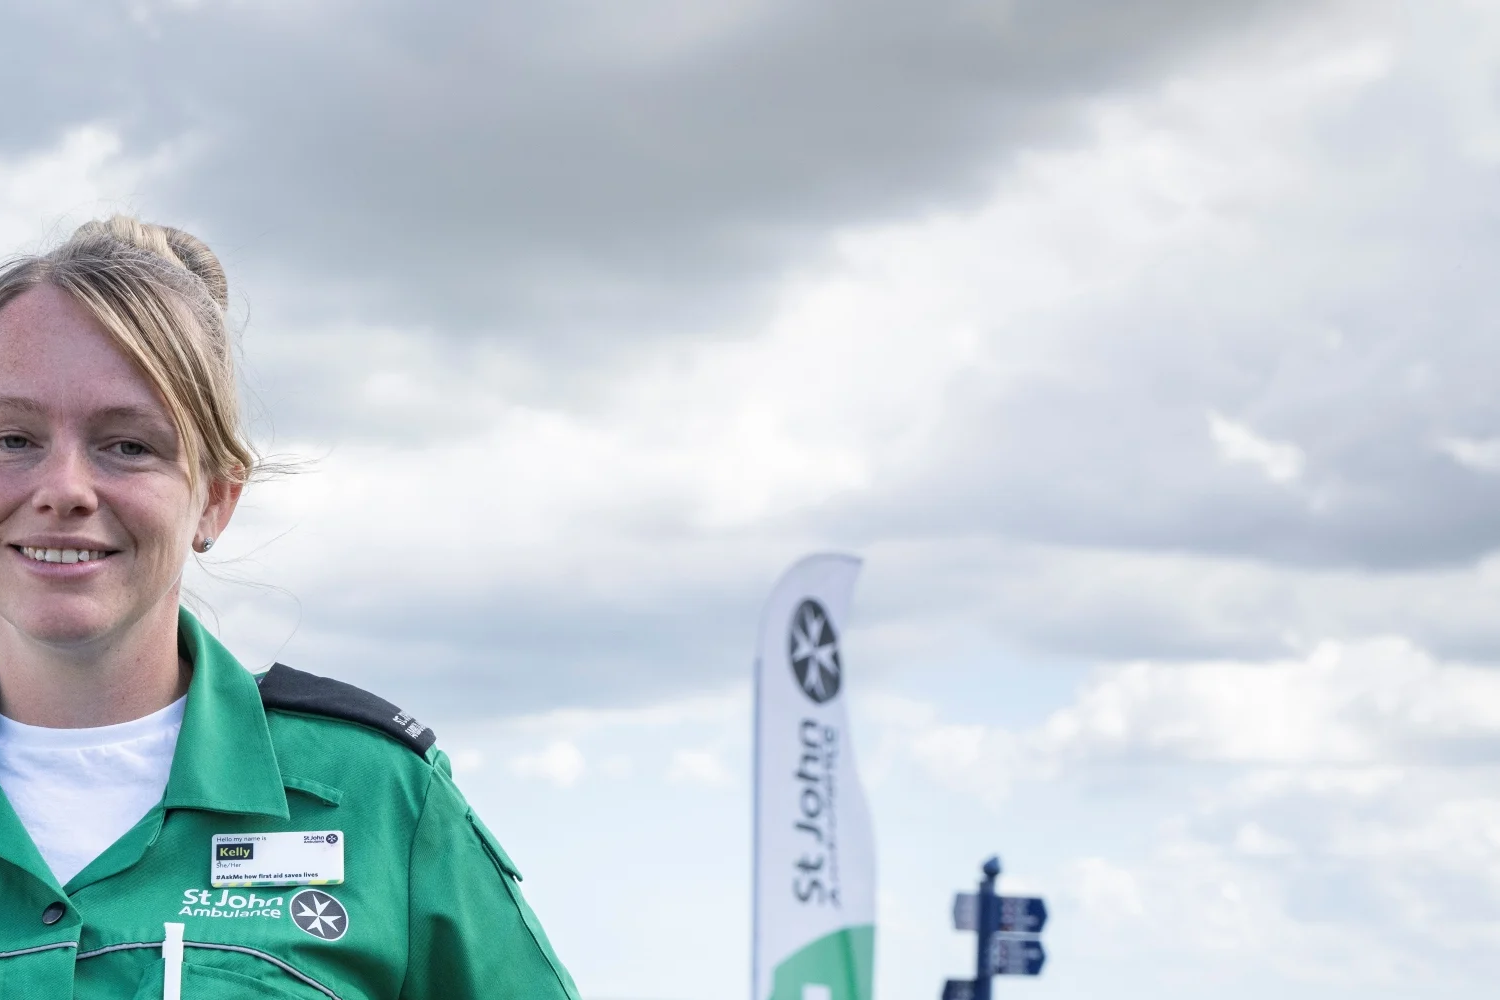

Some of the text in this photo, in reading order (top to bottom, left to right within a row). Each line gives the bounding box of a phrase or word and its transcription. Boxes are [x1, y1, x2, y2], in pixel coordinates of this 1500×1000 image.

[792, 717, 825, 907] St John
[220, 847, 250, 858] Kelly
[182, 889, 283, 908] St John
[178, 906, 282, 918] Ambulance
